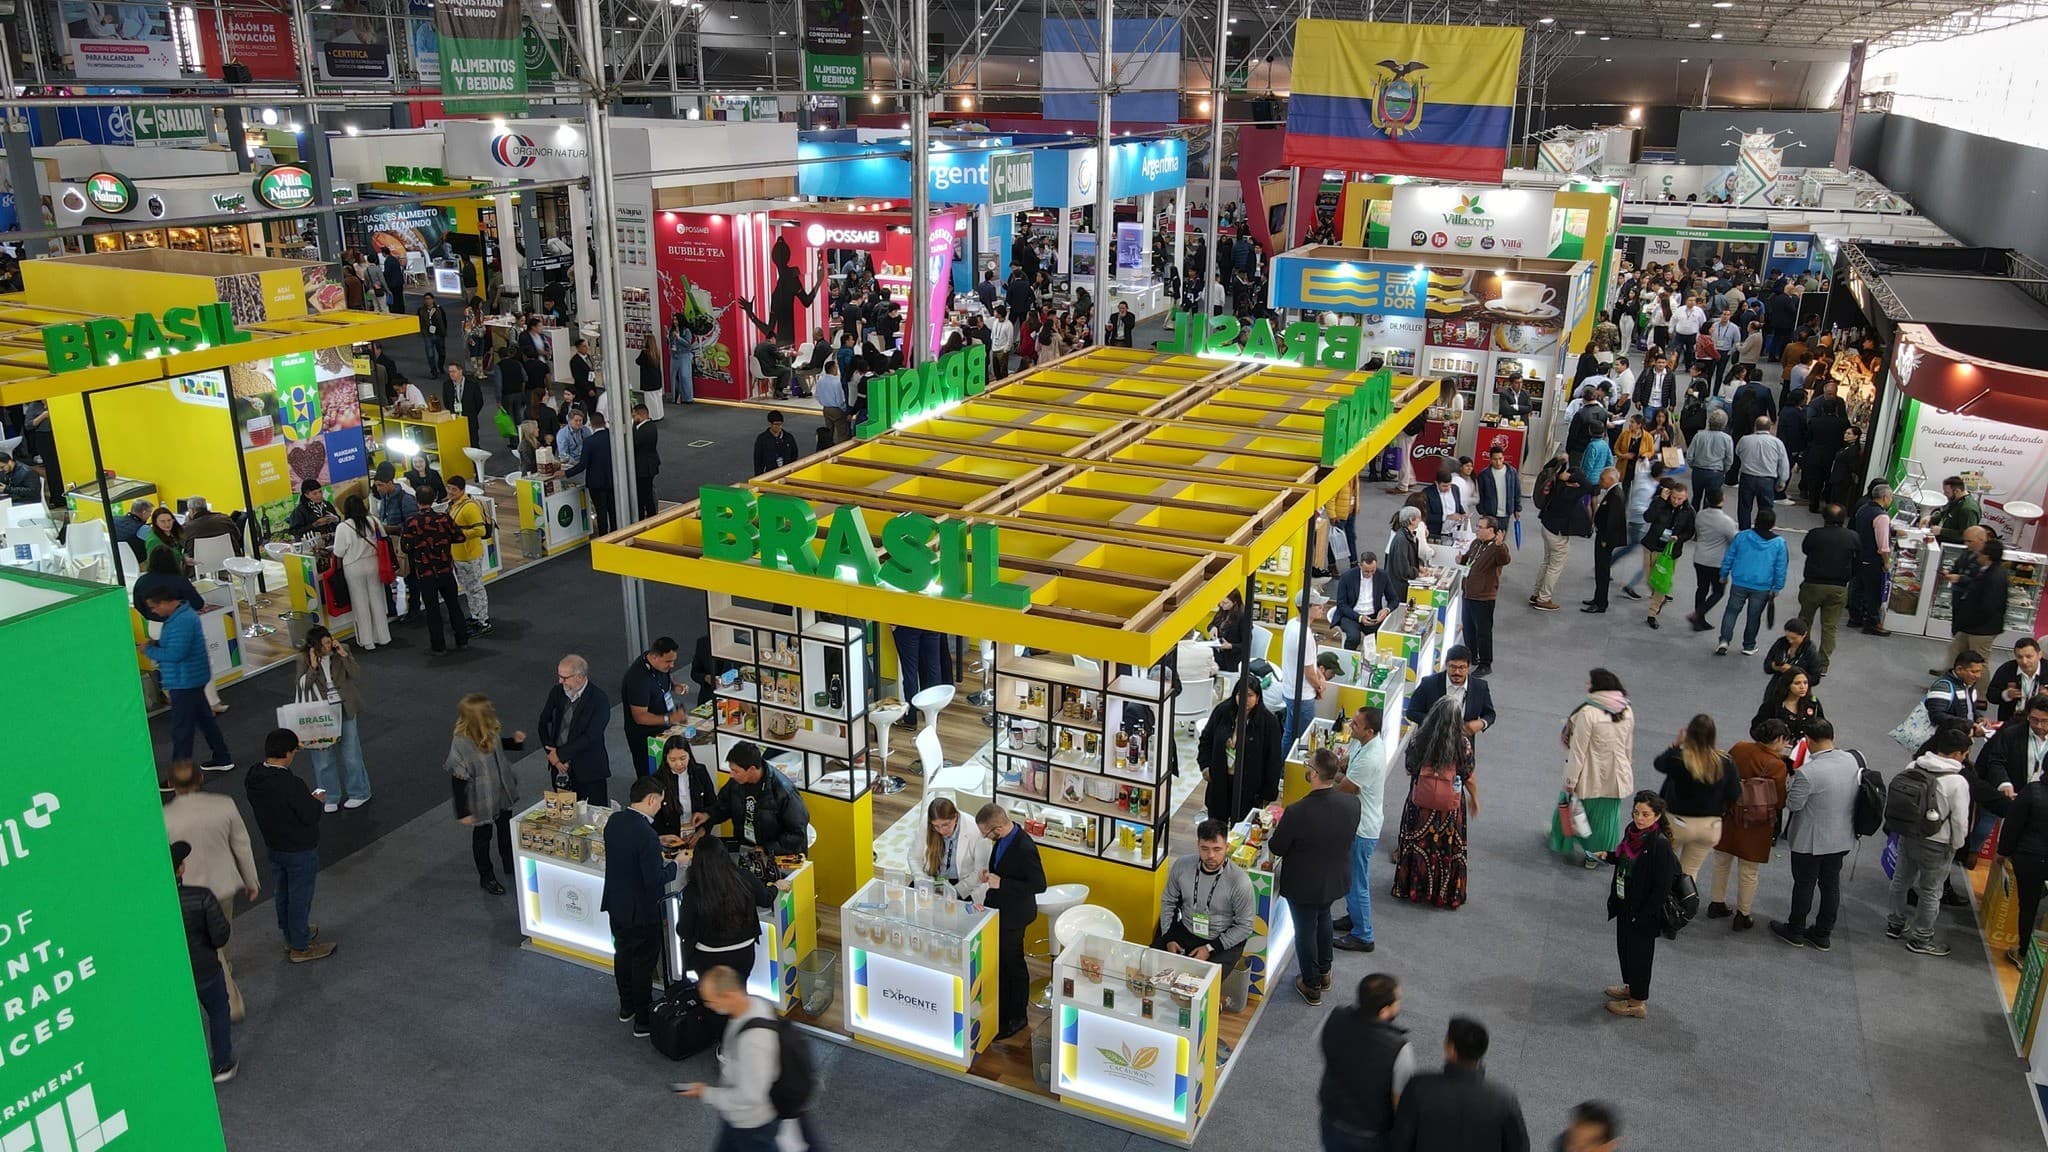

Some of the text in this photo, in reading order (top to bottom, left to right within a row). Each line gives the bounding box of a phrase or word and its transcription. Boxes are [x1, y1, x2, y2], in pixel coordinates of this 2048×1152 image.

[453, 8, 497, 18] EL MUNDO
[229, 21, 275, 32] SALÓN DE
[216, 33, 276, 43] INOVACIÓN
[103, 55, 136, 63] ALCANZAR
[333, 49, 369, 59] CERTIFICA
[451, 58, 517, 74] ALIMENTOS
[813, 64, 857, 75] ALIMENTOS
[455, 76, 514, 91] Y BEBIDAS
[815, 75, 855, 85] Y BEBIDAS
[158, 108, 205, 132] SALIDA
[512, 146, 590, 159] ORGINOR NATURA
[384, 165, 450, 187] BRASIL
[1141, 155, 1179, 182] Argentina
[97, 178, 118, 193] Villa
[272, 173, 302, 187] Villa
[1006, 162, 1033, 194] SALIDA
[94, 190, 124, 203] Natura
[269, 186, 311, 201] Natura
[212, 192, 246, 211] Veggie
[357, 214, 386, 225] BRASIL
[396, 208, 438, 220] ALIMENTO
[1441, 213, 1496, 230] Villacorp
[367, 224, 390, 233] PARA
[401, 218, 432, 229] MUNDO
[685, 226, 709, 235] POSSMEI
[825, 228, 880, 246] POSSMEI
[929, 228, 953, 246] OSSMEI
[1413, 232, 1425, 241] GO
[1500, 239, 1522, 249] Villa
[668, 246, 726, 258] BUBBLE TEA
[1384, 284, 1416, 298] CUA
[1383, 297, 1416, 310] DOR
[1399, 322, 1423, 332] MÜLLER
[42, 301, 252, 375] BRASIL
[178, 377, 225, 399] BRASIL
[1321, 367, 1395, 467] BRASIL
[1920, 425, 2044, 445] Produciendo y endulzando
[1934, 441, 2023, 456] recetas, desde hace
[338, 455, 355, 464] QUESO
[699, 484, 1032, 610] BRASIL
[298, 715, 334, 725] BRASIL
[0, 939, 65, 986] NT,
[882, 989, 938, 1012] EXPOENTE
[0, 1061, 85, 1124] RNMENT
